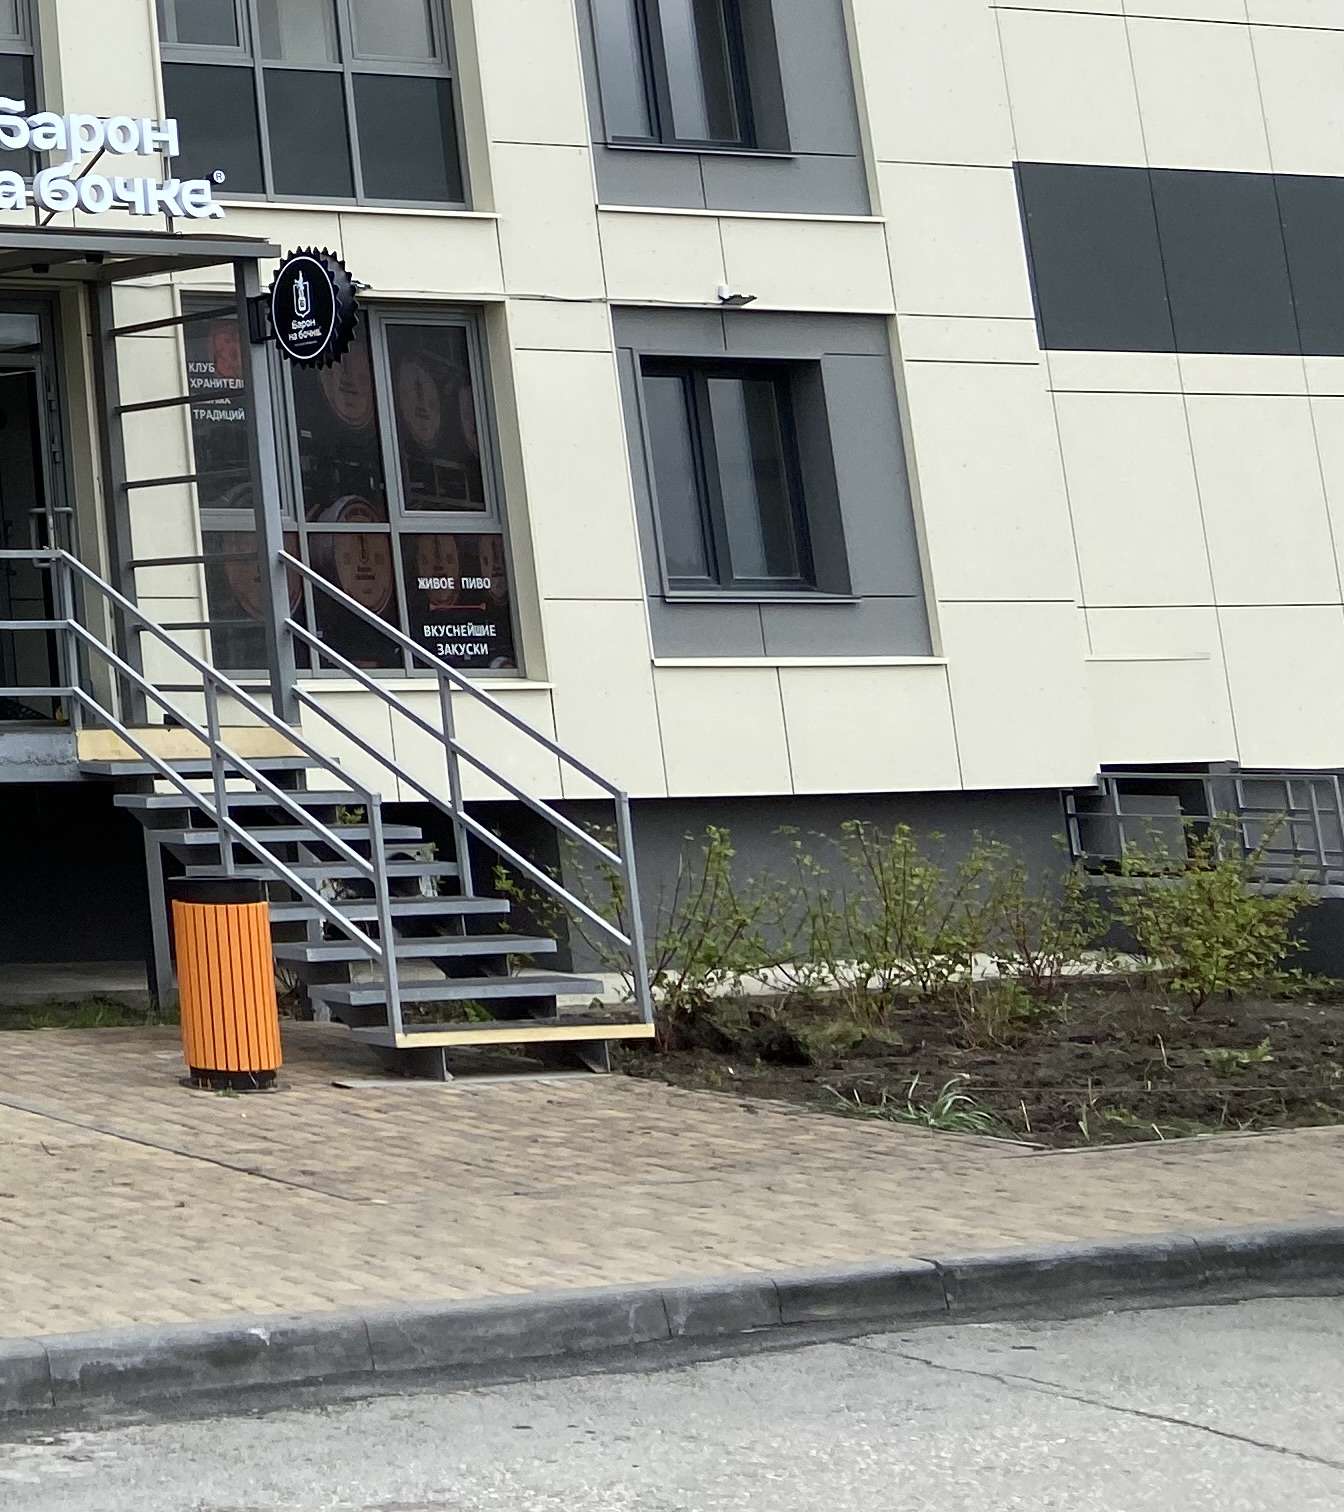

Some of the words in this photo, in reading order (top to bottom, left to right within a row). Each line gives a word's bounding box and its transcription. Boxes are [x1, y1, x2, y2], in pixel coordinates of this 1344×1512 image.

[188, 362, 216, 373] КЛУБ
[193, 407, 246, 422] ТРАДИЦИЙ
[417, 577, 455, 590] ЖИВОЕ
[461, 577, 491, 589] ПИВО
[423, 621, 497, 637] ВКУСНЕЙШИЕ
[436, 643, 489, 656] ЗАКУСКИ
